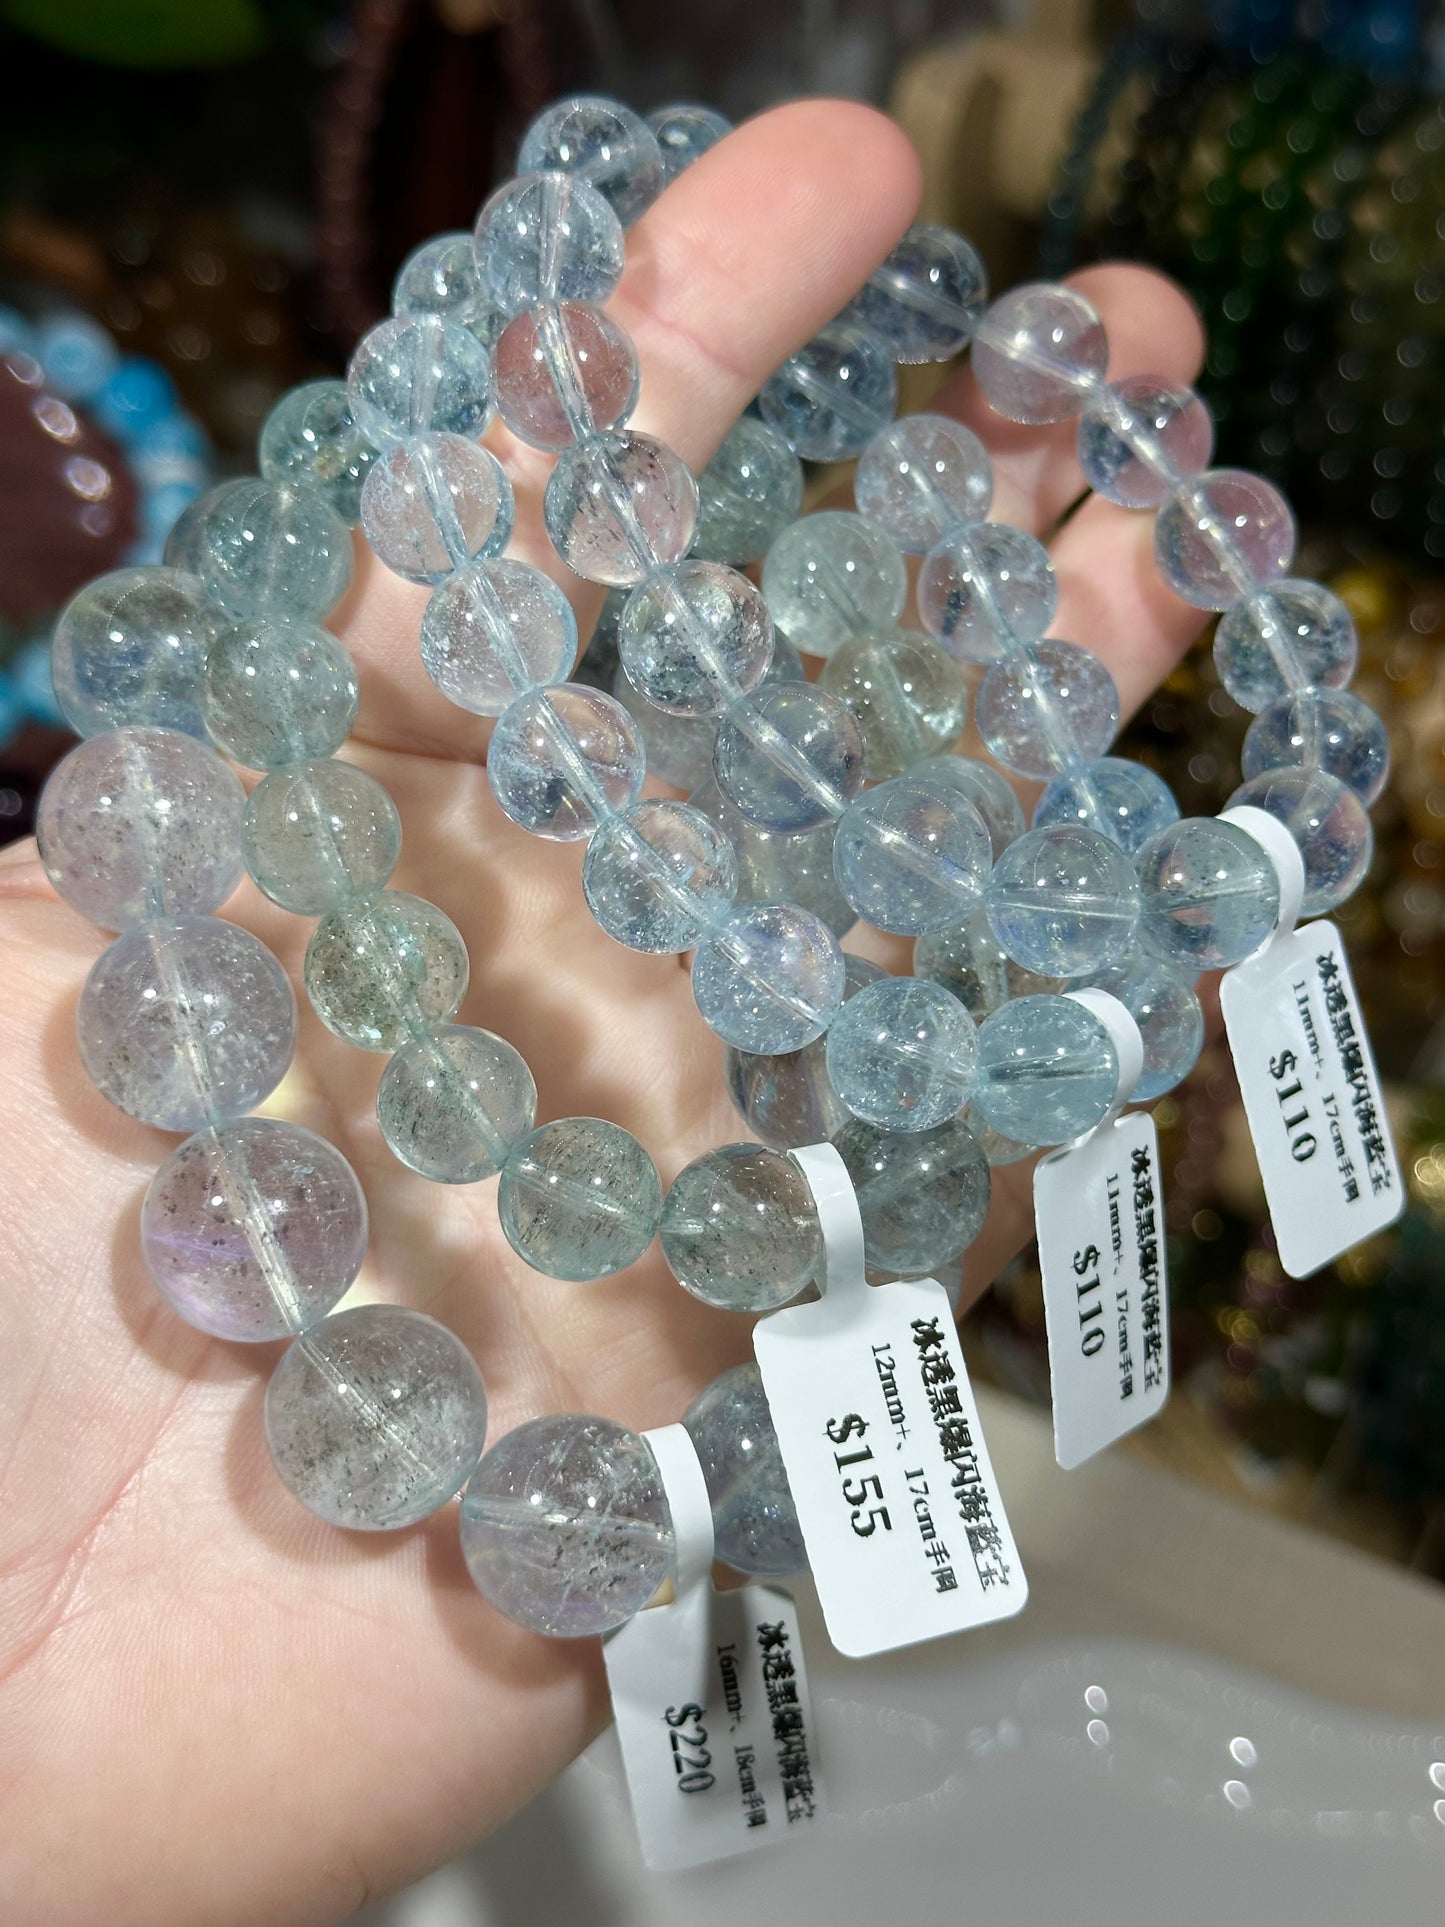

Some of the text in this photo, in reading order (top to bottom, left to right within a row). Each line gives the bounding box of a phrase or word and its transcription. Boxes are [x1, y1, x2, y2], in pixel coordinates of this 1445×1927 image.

[1267, 1048, 1317, 1164] $110
[1071, 1243, 1105, 1358] $110
[822, 1412, 895, 1539] $155
[659, 1702, 717, 1794] $220
